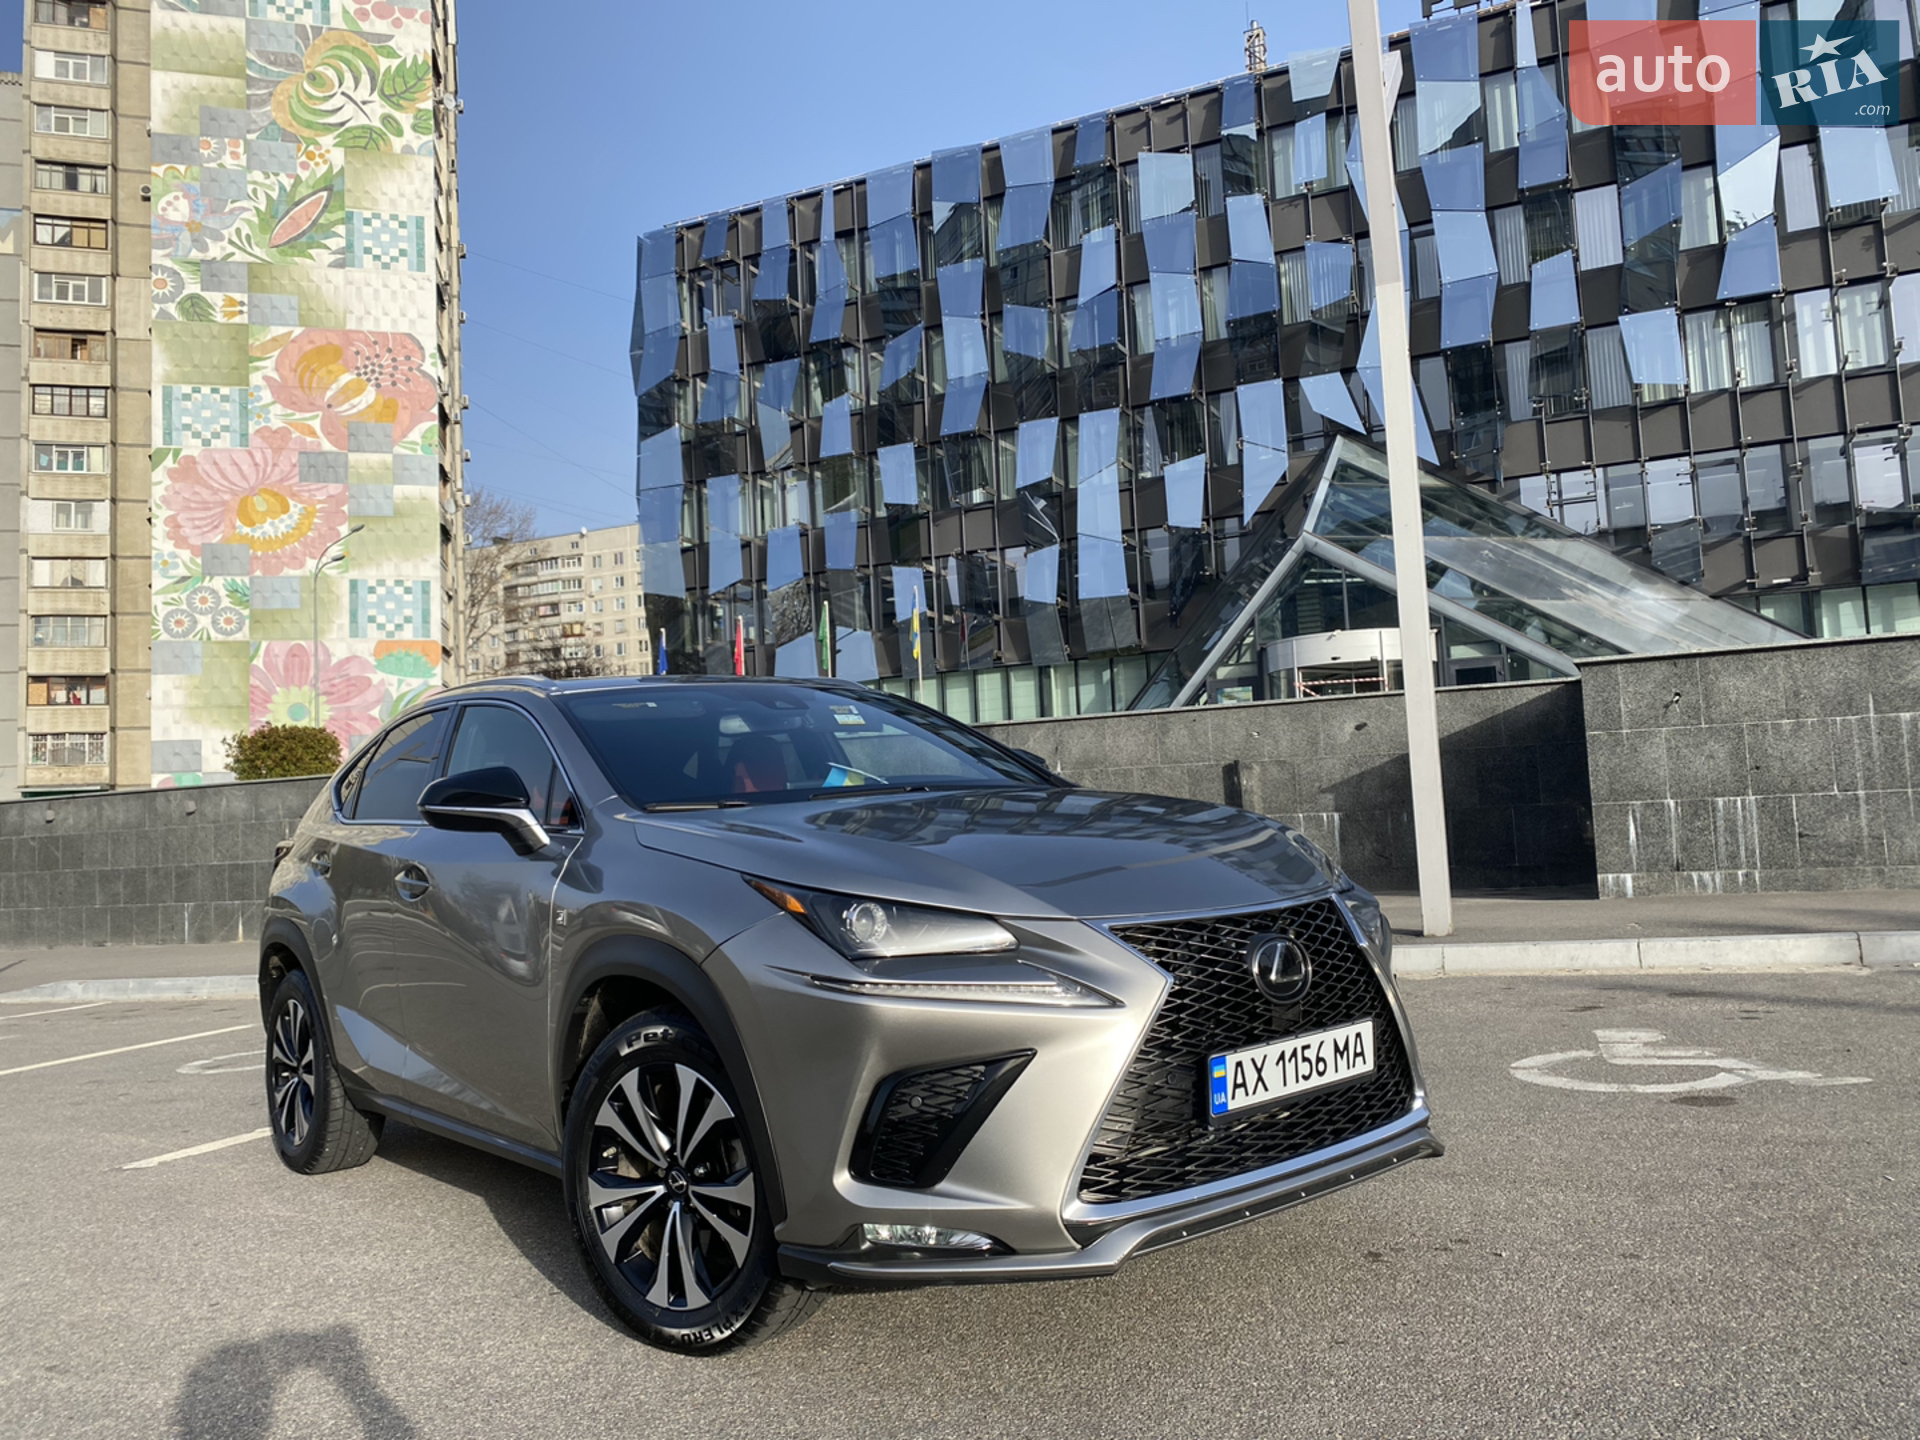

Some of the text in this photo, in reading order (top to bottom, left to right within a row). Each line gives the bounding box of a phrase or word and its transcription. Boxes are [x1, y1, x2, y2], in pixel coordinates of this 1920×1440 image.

[1231, 1031, 1367, 1101] AX 1156 MA
[1213, 1091, 1227, 1105] UA
